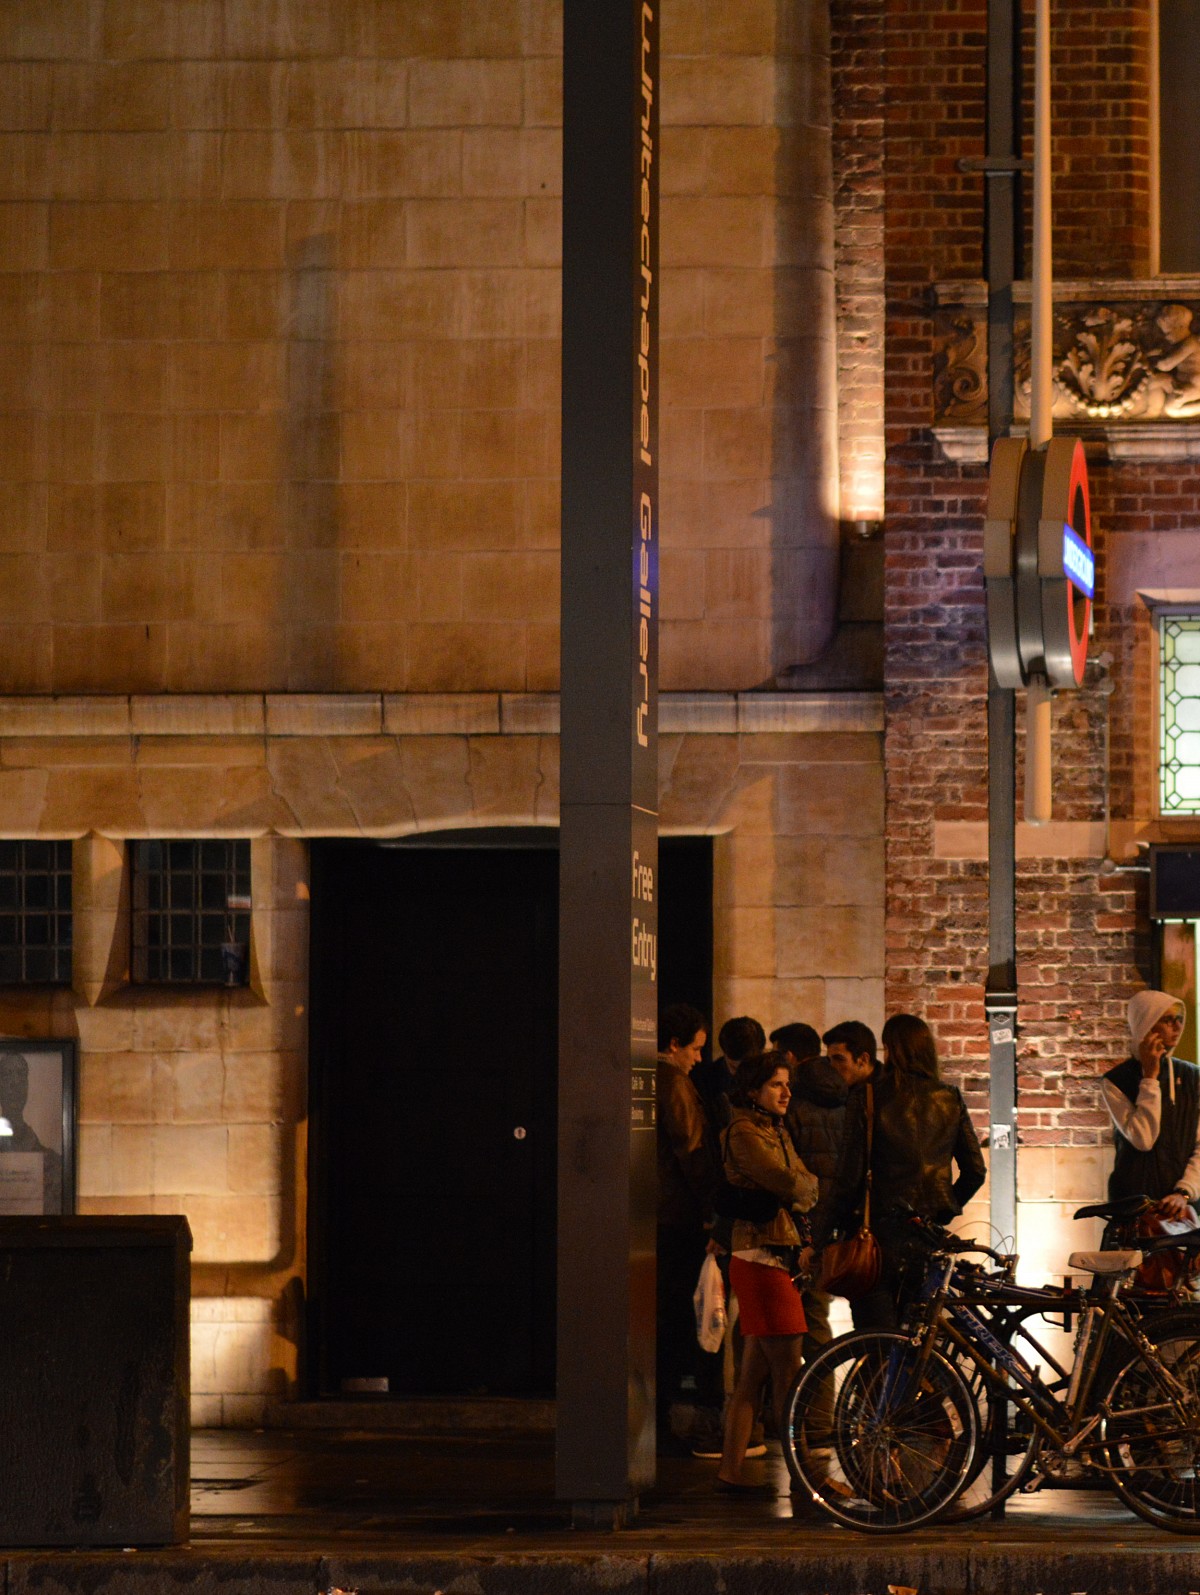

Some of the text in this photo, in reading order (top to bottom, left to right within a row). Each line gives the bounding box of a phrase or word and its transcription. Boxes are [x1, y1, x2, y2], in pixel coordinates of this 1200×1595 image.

[636, 2, 653, 748] Whitechapel Gallery
[632, 851, 653, 902] Free
[632, 918, 657, 981] Entry
